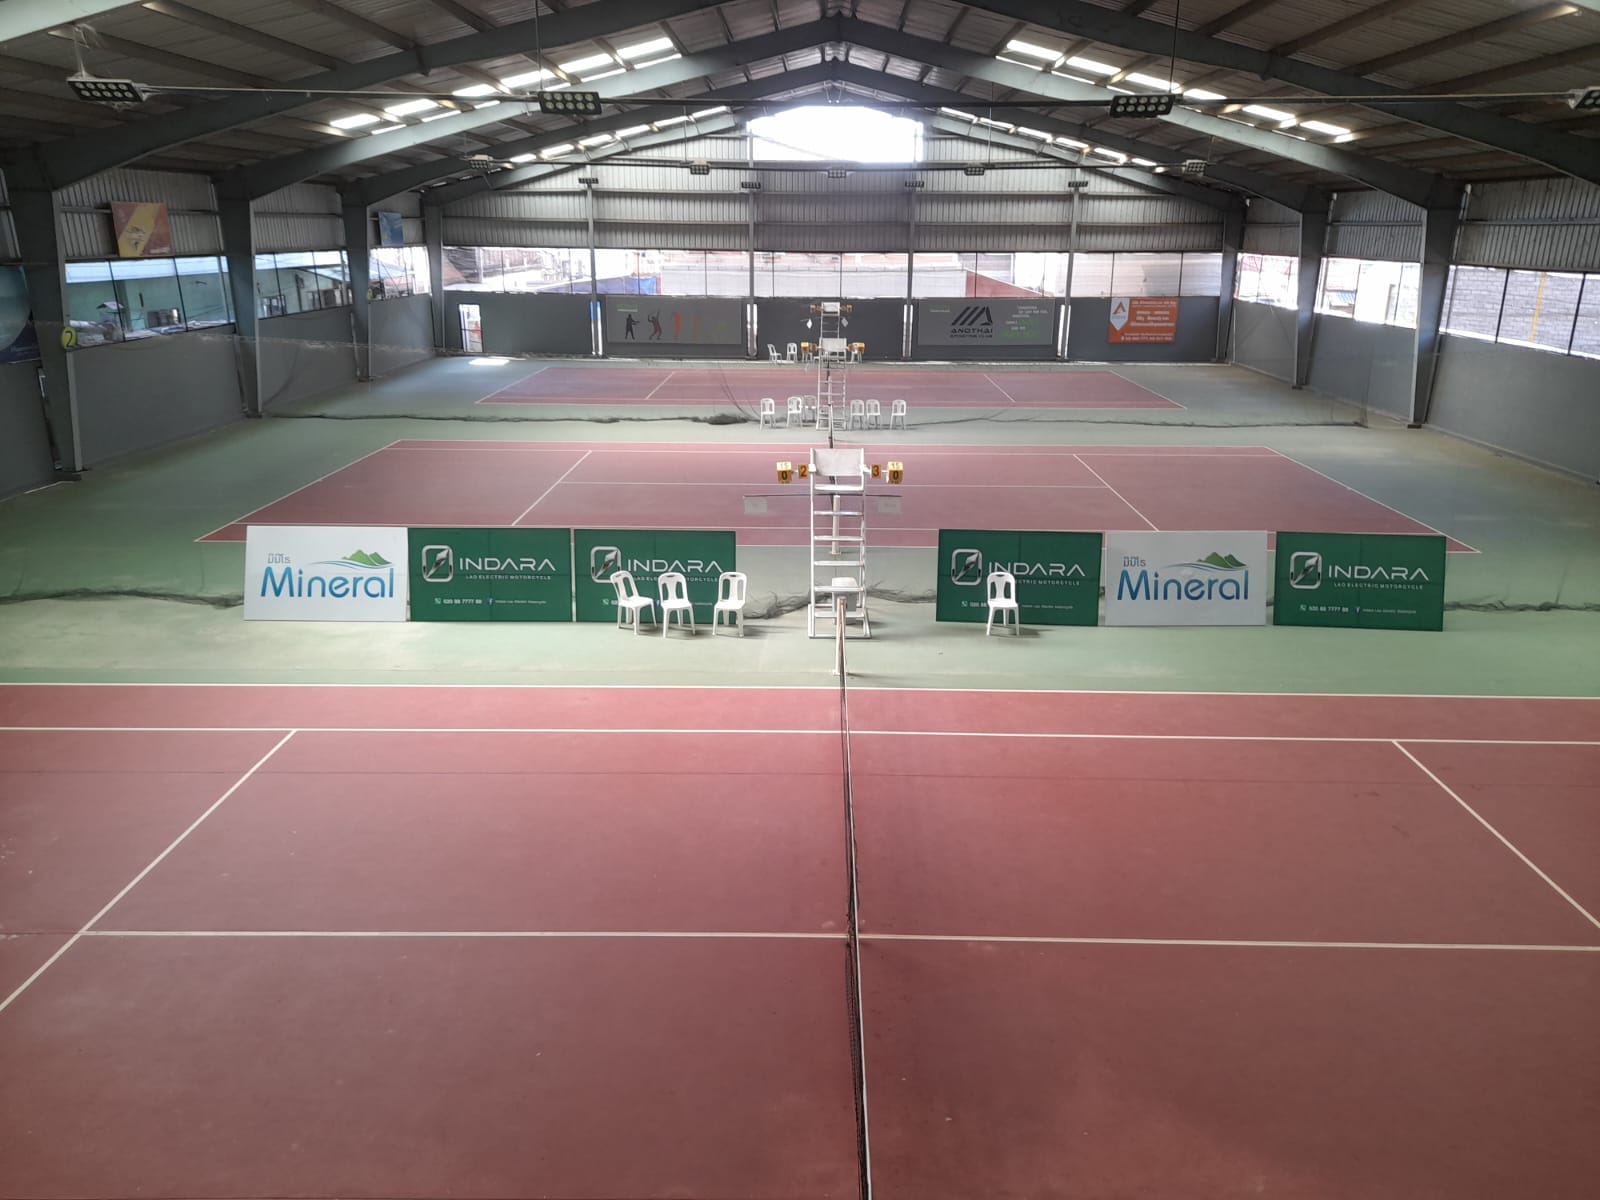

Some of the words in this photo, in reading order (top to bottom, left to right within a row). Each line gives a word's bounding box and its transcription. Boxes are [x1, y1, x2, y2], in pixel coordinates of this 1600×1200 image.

[65, 331, 74, 347] 2
[782, 471, 788, 480] 0
[800, 465, 808, 477] 2
[873, 465, 880, 477] 3
[893, 471, 899, 480] 0
[459, 558, 556, 571] INDARA
[627, 559, 723, 573] INDARA
[989, 562, 1086, 577] INDARA
[1328, 565, 1430, 581] INDARA
[260, 566, 394, 598] Mineral
[1117, 569, 1249, 601] Mineral
